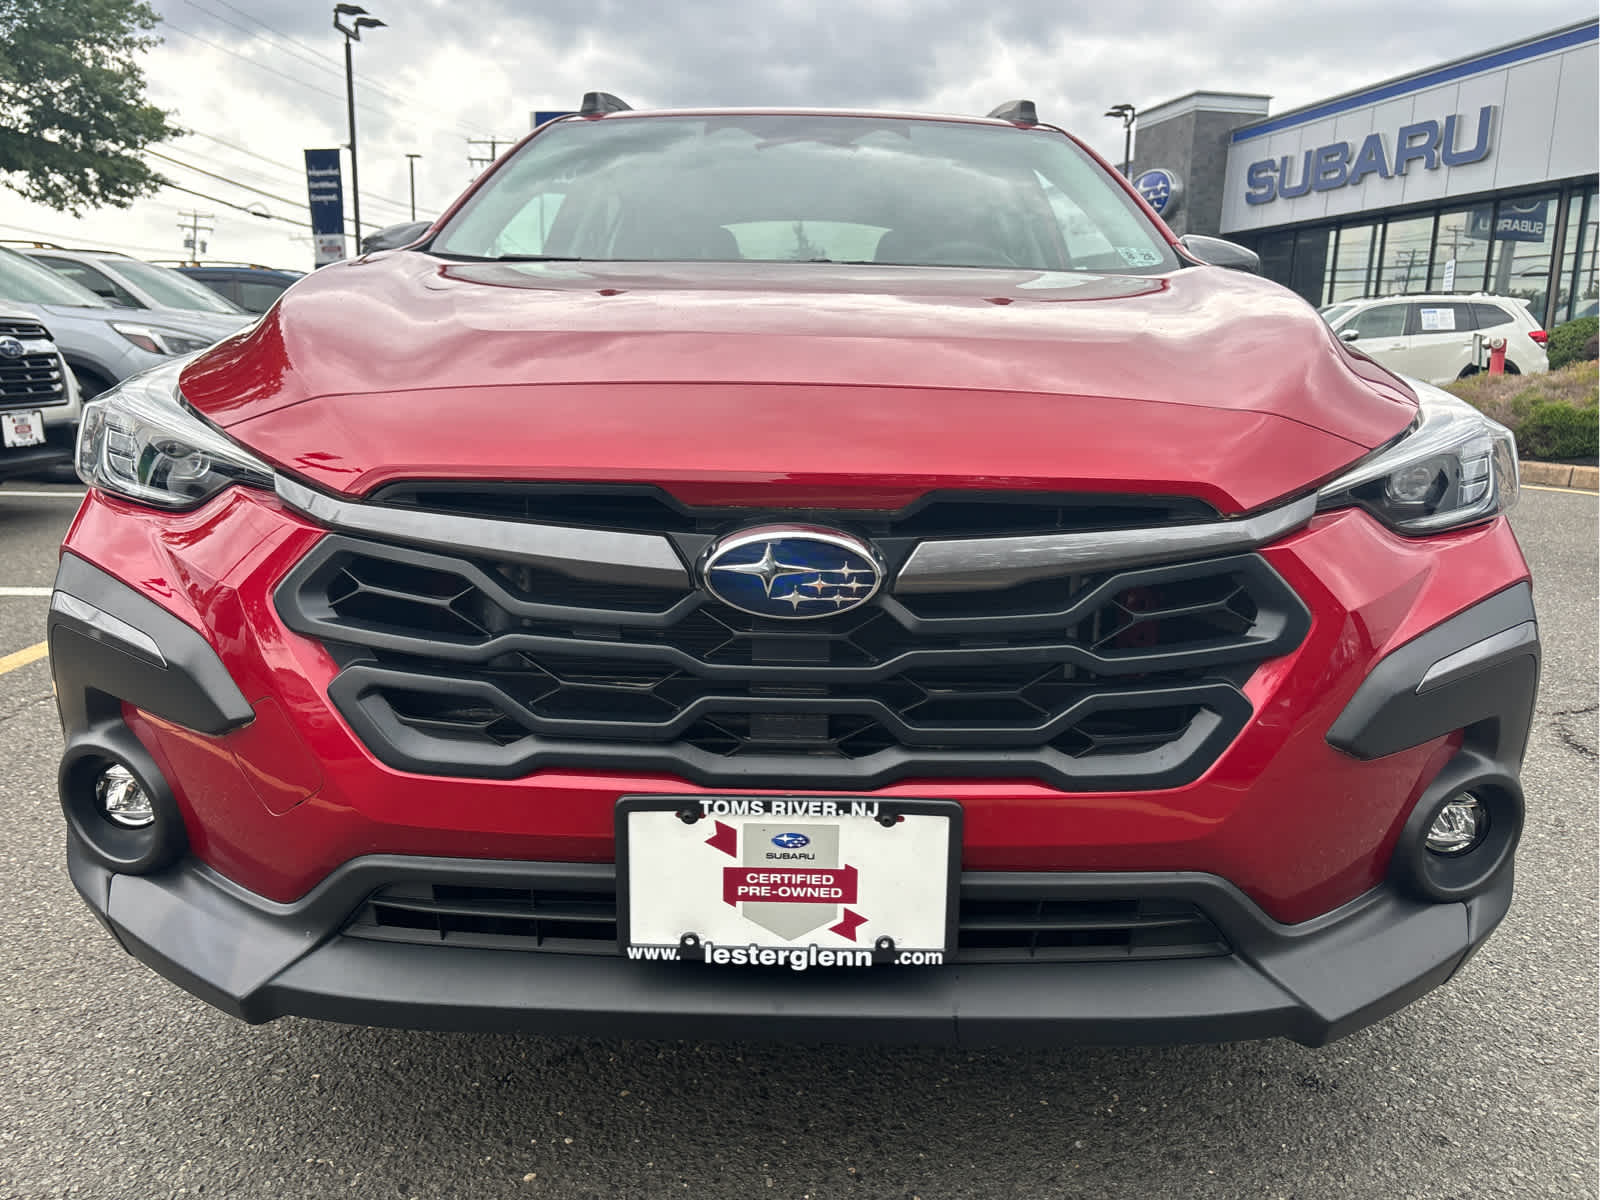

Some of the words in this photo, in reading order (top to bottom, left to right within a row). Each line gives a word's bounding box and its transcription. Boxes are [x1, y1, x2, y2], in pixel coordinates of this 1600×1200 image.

[1245, 105, 1496, 205] SUBARU
[700, 801, 764, 816] TOMS
[851, 802, 879, 818] NJ
[765, 852, 815, 860] SUBARU
[746, 873, 834, 885] CERTIFIED
[737, 886, 842, 898] PRE-OWNED
[627, 946, 681, 961] www.
[705, 946, 873, 970] lesterglenn
[894, 950, 943, 965] .com
